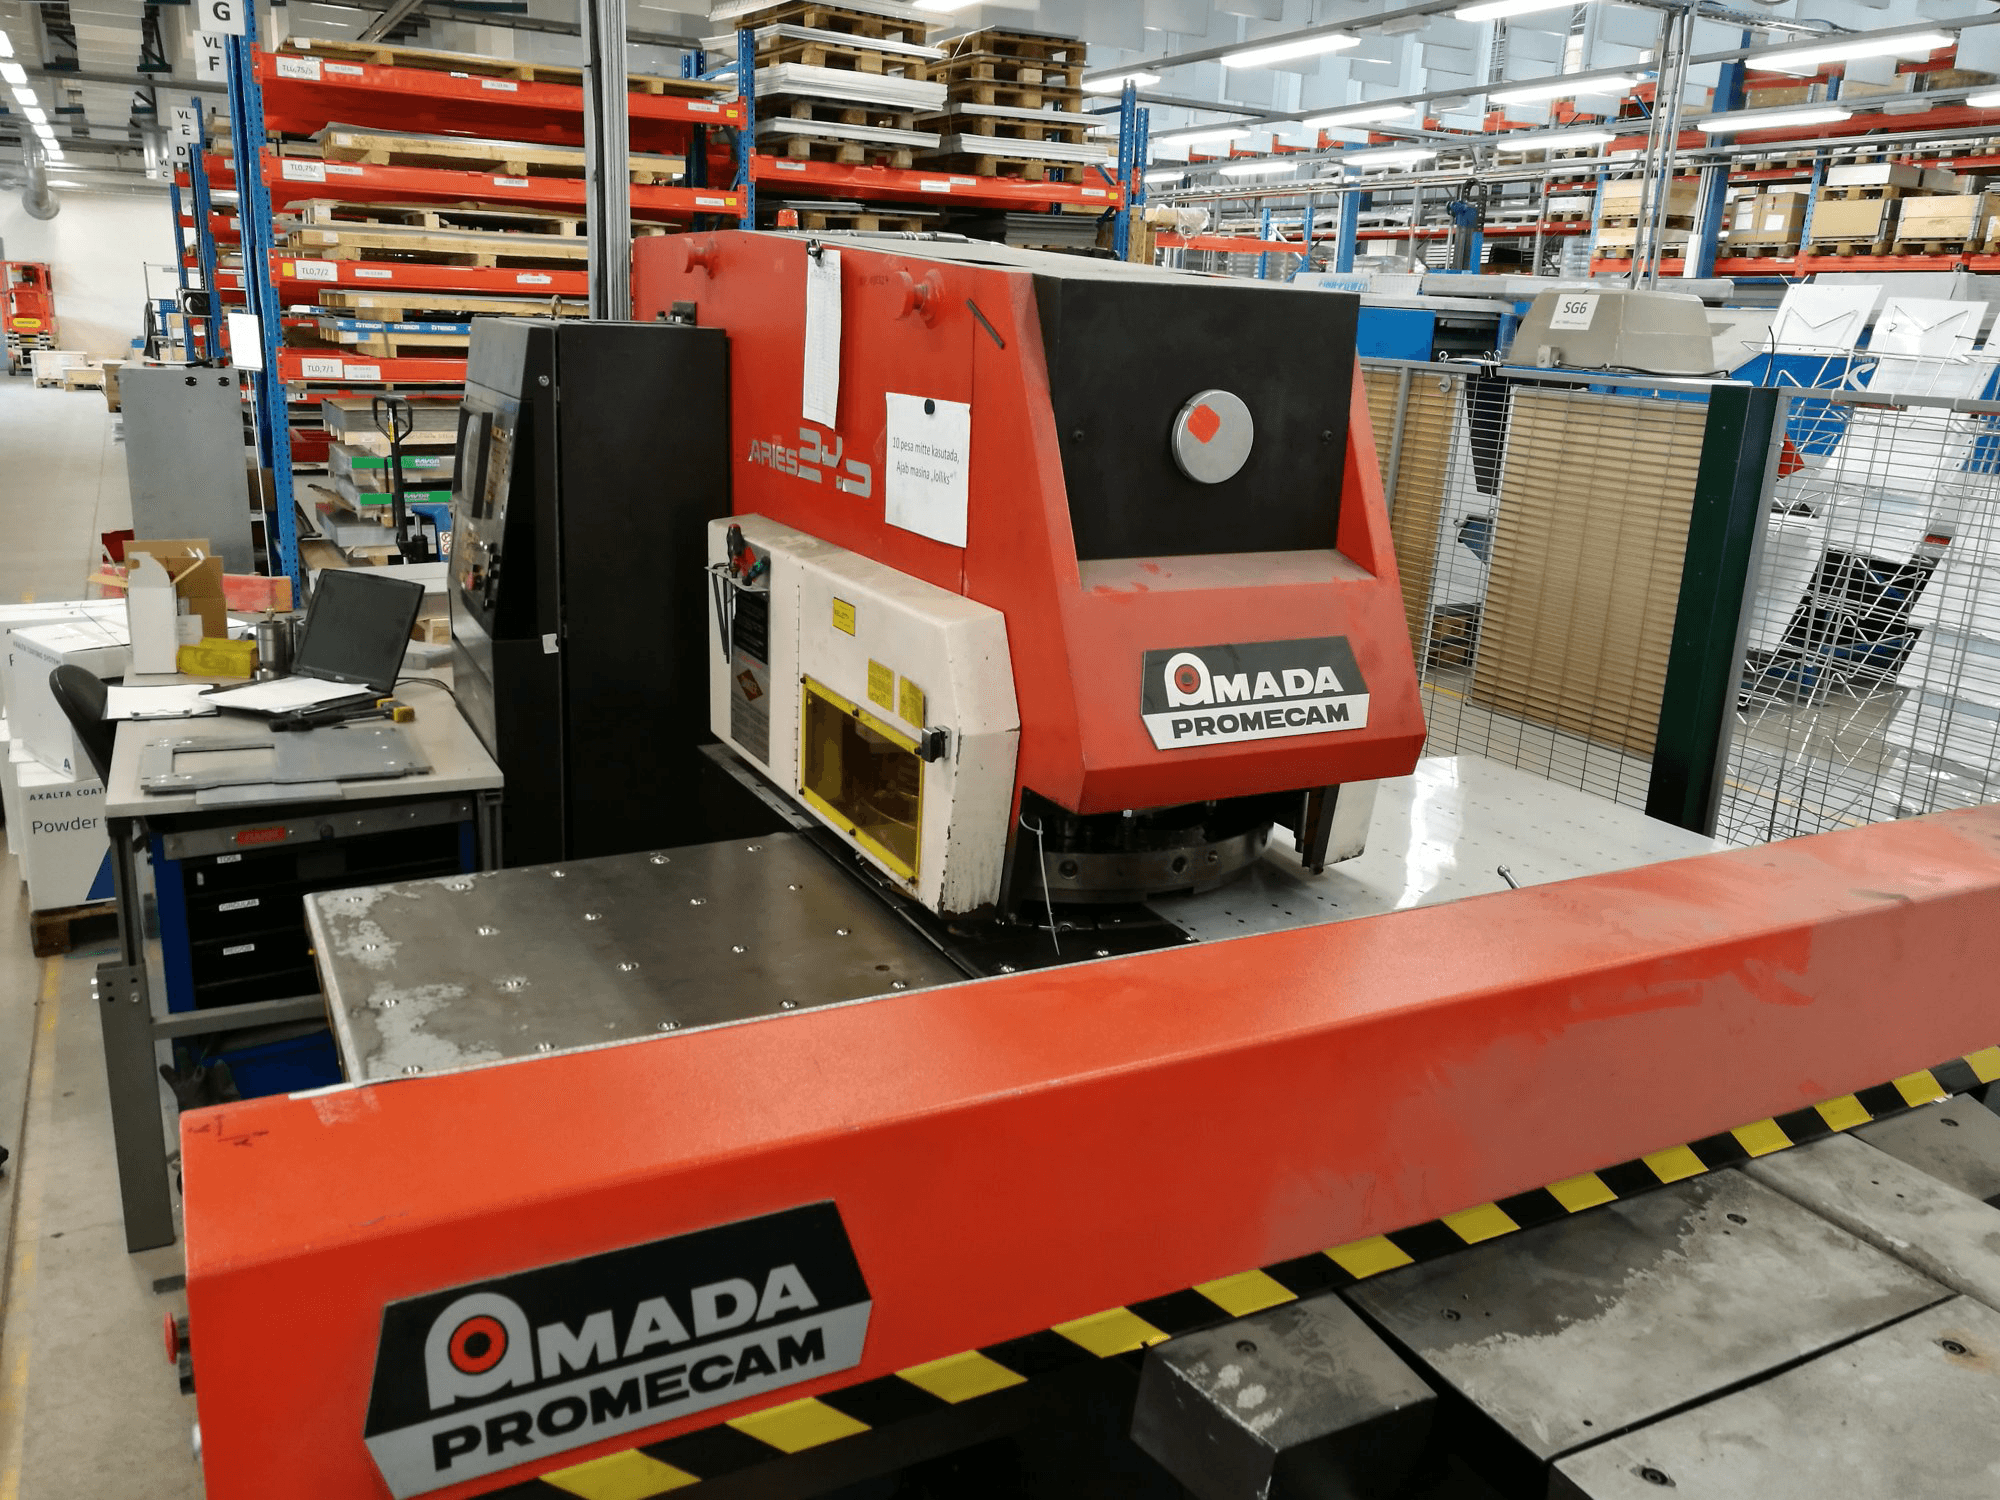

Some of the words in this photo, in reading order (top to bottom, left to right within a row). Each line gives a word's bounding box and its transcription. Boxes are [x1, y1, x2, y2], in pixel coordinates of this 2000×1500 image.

[213, 2, 231, 21] G
[203, 36, 222, 49] VL
[209, 56, 220, 71] F
[177, 111, 191, 120] VL
[182, 125, 191, 135] E
[176, 146, 186, 156] D
[1563, 301, 1588, 314] SG6
[748, 439, 798, 476] ARIES
[893, 436, 900, 449] 10
[901, 440, 914, 452] pesa
[915, 442, 931, 456] mitte
[932, 444, 960, 464] kasutada,
[896, 460, 910, 475] Ajab
[910, 466, 930, 480] masina
[1164, 653, 1344, 708] AMADA
[1172, 703, 1350, 739] PROMECAM
[29, 791, 72, 801] AXALTA
[76, 787, 103, 797] COAT
[32, 816, 98, 835] Powder
[425, 1263, 819, 1410] AMADA
[432, 1328, 826, 1472] PROMECAM
